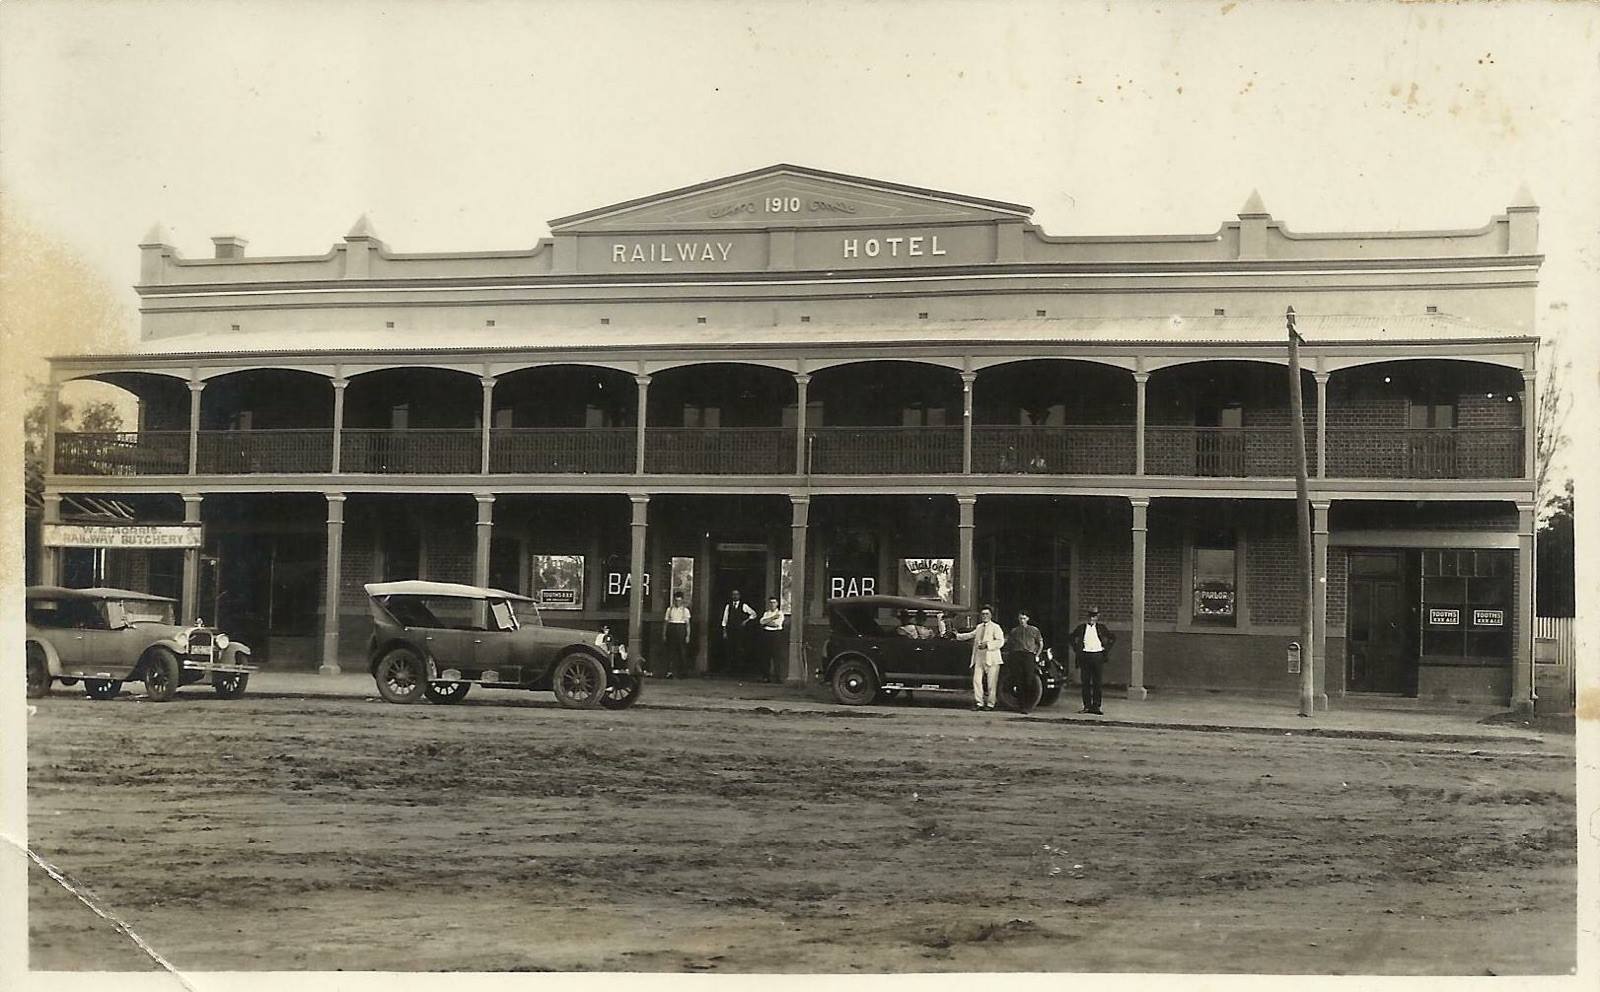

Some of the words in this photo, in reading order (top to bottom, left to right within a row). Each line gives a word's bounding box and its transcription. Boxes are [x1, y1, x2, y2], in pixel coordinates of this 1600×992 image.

[764, 197, 801, 213] 1910
[612, 242, 733, 263] RAILWAY
[843, 235, 947, 258] HOTEL
[63, 534, 114, 544] RAILWAY
[121, 534, 184, 545] BUTCHERY
[608, 573, 650, 595] BAR
[831, 578, 875, 599] BAR
[1201, 591, 1228, 600] PARLOR
